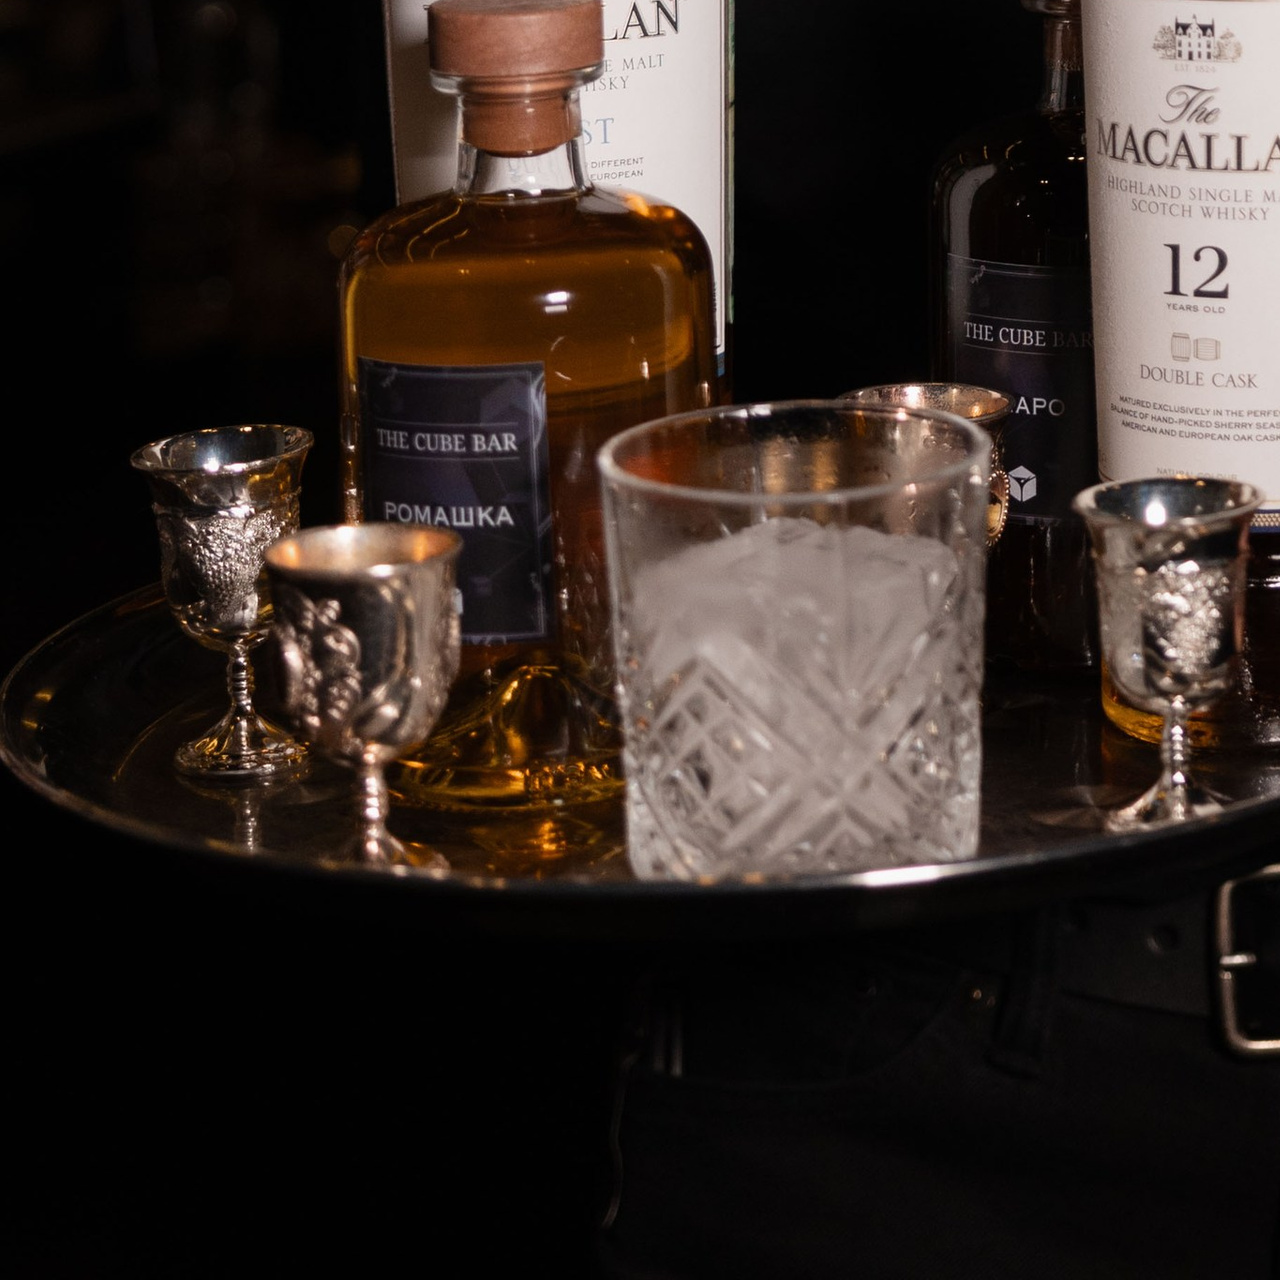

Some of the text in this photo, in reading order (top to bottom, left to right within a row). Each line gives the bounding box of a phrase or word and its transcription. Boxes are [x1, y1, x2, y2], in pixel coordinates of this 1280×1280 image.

[622, 53, 665, 72] MALT
[1158, 84, 1220, 124] The
[590, 157, 644, 169] DIFFERENT
[590, 169, 644, 181] EUROPEAN
[1107, 175, 1182, 199] HIGHLAND
[1189, 187, 1253, 203] SINGLE
[1131, 198, 1270, 222] SCOTCH WHISKY
[1163, 243, 1230, 299] 12
[1166, 302, 1226, 314] YEARS OLD
[963, 321, 994, 342] THE
[999, 327, 1046, 347] CUBE
[1140, 363, 1259, 389] DOUBLE CASK
[1110, 402, 1138, 419] BALANCE
[1138, 411, 1149, 421] OF
[1151, 414, 1212, 428] HAND-PICKED
[1214, 420, 1253, 429] SHERRY
[1119, 394, 1151, 409] MATURED
[1153, 402, 1211, 417] EXCLUSIVELY
[1213, 408, 1223, 417] IN
[1225, 409, 1244, 417] THE
[377, 428, 518, 453] THE CUBE BAR
[1121, 419, 1158, 435] AMERICAN
[1158, 428, 1177, 438] AND
[1178, 430, 1231, 441] EUROPEAN
[1233, 433, 1254, 441] OAK
[384, 501, 515, 527] РОМАШКА
